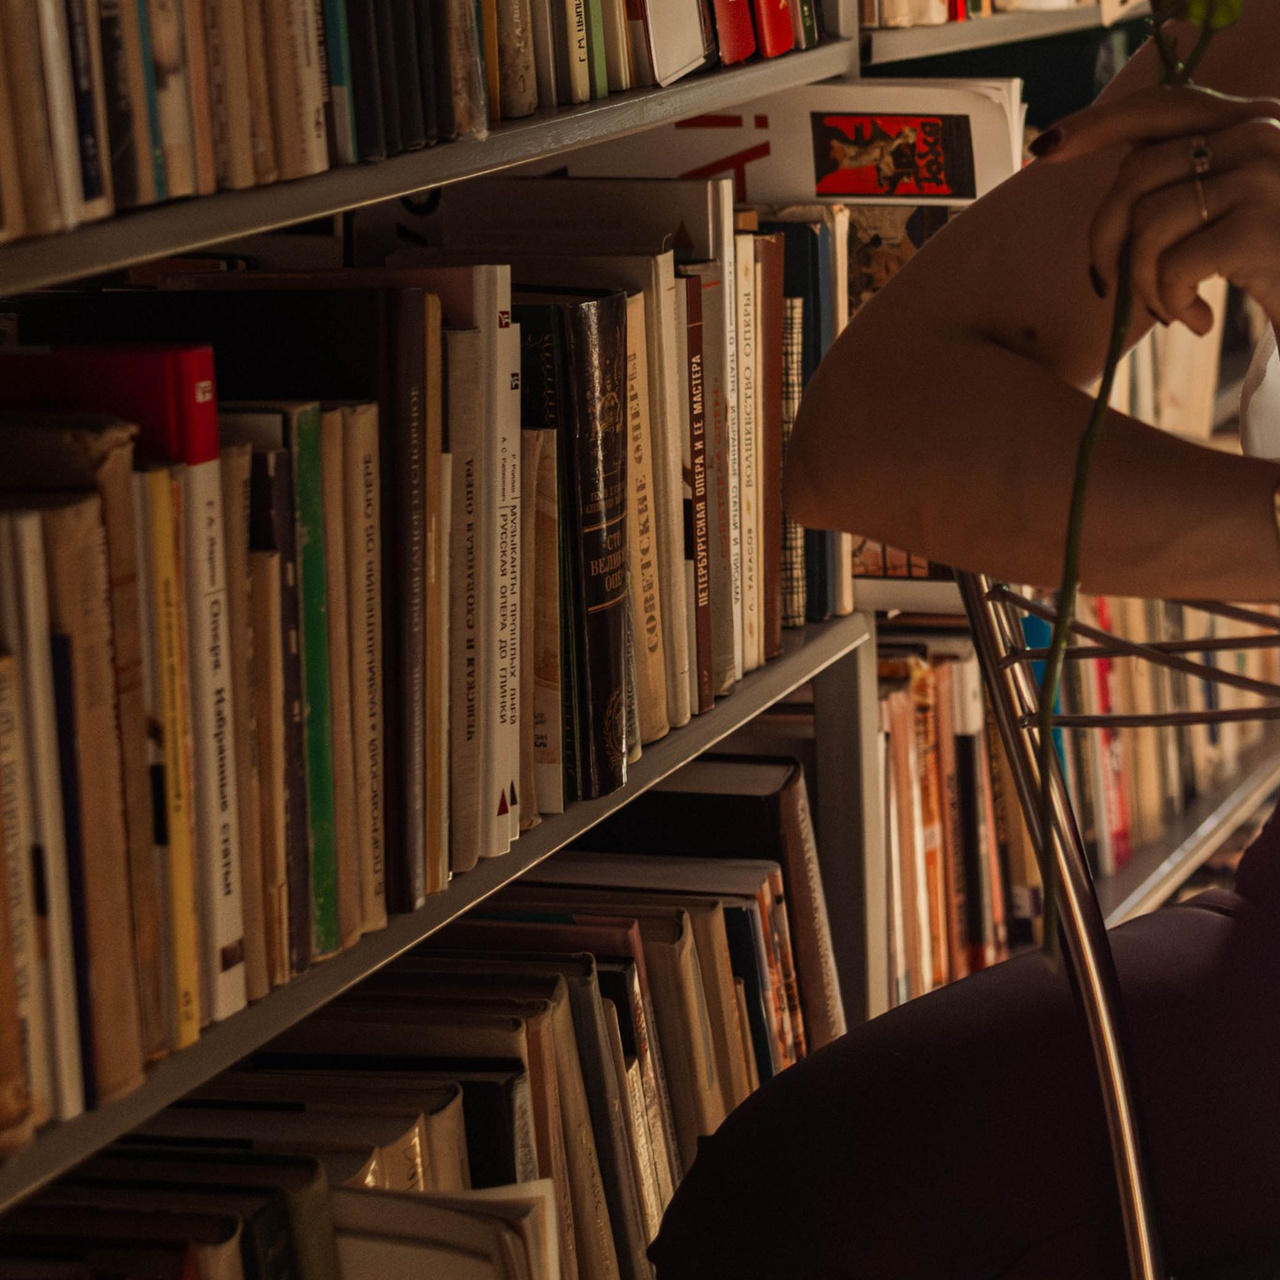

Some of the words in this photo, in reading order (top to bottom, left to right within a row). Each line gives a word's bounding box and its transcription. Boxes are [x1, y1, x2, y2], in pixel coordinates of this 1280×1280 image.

[576, 34, 586, 49] М.
[577, 52, 587, 63] Г.
[741, 287, 752, 357] ОПЕРЫ
[625, 351, 643, 465] ОПЕРЫ
[690, 352, 704, 415] МАСТЕРА
[692, 417, 705, 435] ЕЕ
[693, 438, 705, 451] И
[728, 403, 738, 479] ИЗБРАННЫЕ
[741, 363, 755, 489] ВОЛШЕБСТВО
[362, 450, 374, 519] ОПЕРЕ
[464, 456, 474, 517] ОПЕРА
[693, 452, 707, 497] ОПЕРА
[363, 524, 376, 553] ОБ
[730, 484, 739, 532] СТАТЬИ
[464, 520, 475, 631] СЛОВАЦКАЯ
[498, 511, 509, 578] РУССКАЯ
[507, 503, 519, 596] МУЗЫКАНТЫ
[634, 472, 659, 654] СОВЕТСКИЕ
[694, 499, 710, 607] ПЕТЕРБУРГСКАЯ
[746, 526, 755, 591] ТАРАСОВ
[498, 583, 509, 632] ОПЕРА
[732, 551, 741, 608] ПИСЬМА
[364, 559, 378, 717] РАЗМЫШЛЕНИЯ
[465, 636, 475, 651] И
[497, 637, 509, 660] ДО
[508, 601, 518, 679] ПРОШЛЫХ
[465, 655, 475, 742] ЧЕШСКАЯ
[498, 665, 509, 725] ГЛИНКИ
[508, 685, 518, 726] ДНЕЙ
[368, 736, 383, 873] ПОКРОВСКИЙ
